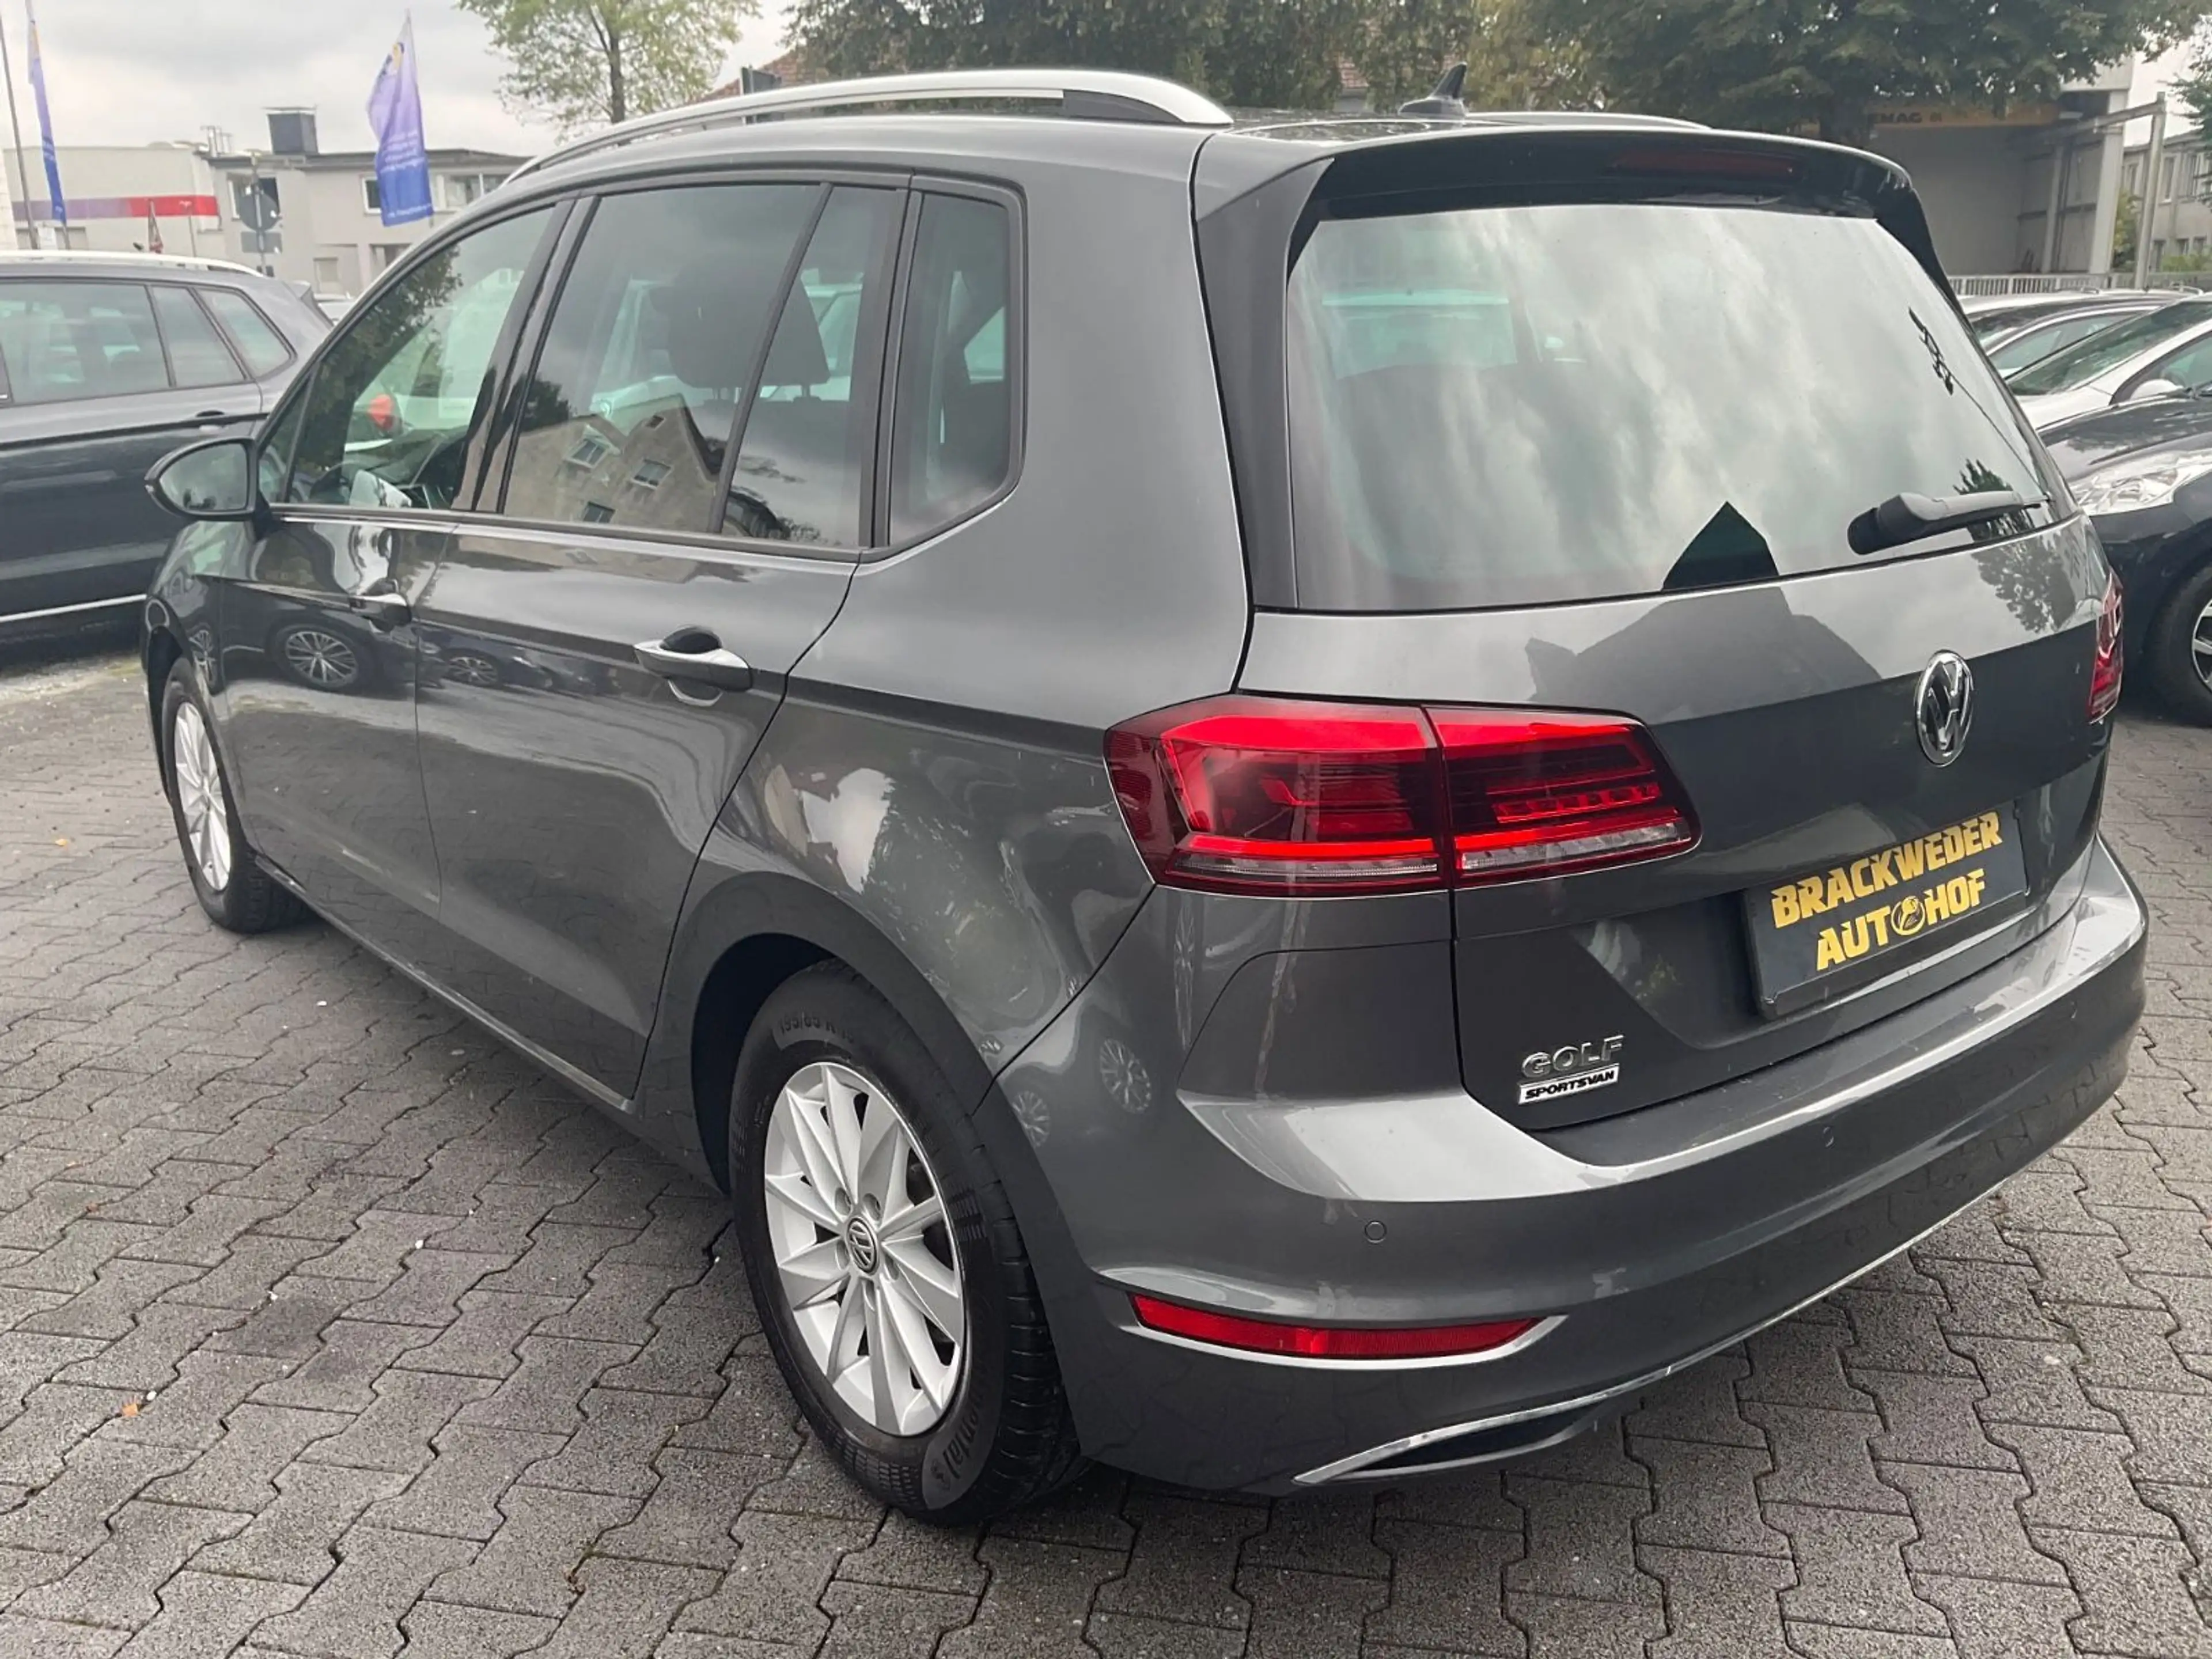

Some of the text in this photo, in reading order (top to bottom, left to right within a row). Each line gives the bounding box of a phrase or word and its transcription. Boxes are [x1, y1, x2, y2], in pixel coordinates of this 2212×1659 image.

[1771, 811, 2003, 928] BRACKWEDER
[1521, 1035, 1624, 1077] GOLF
[1525, 1070, 1614, 1099] SPORTSVAN
